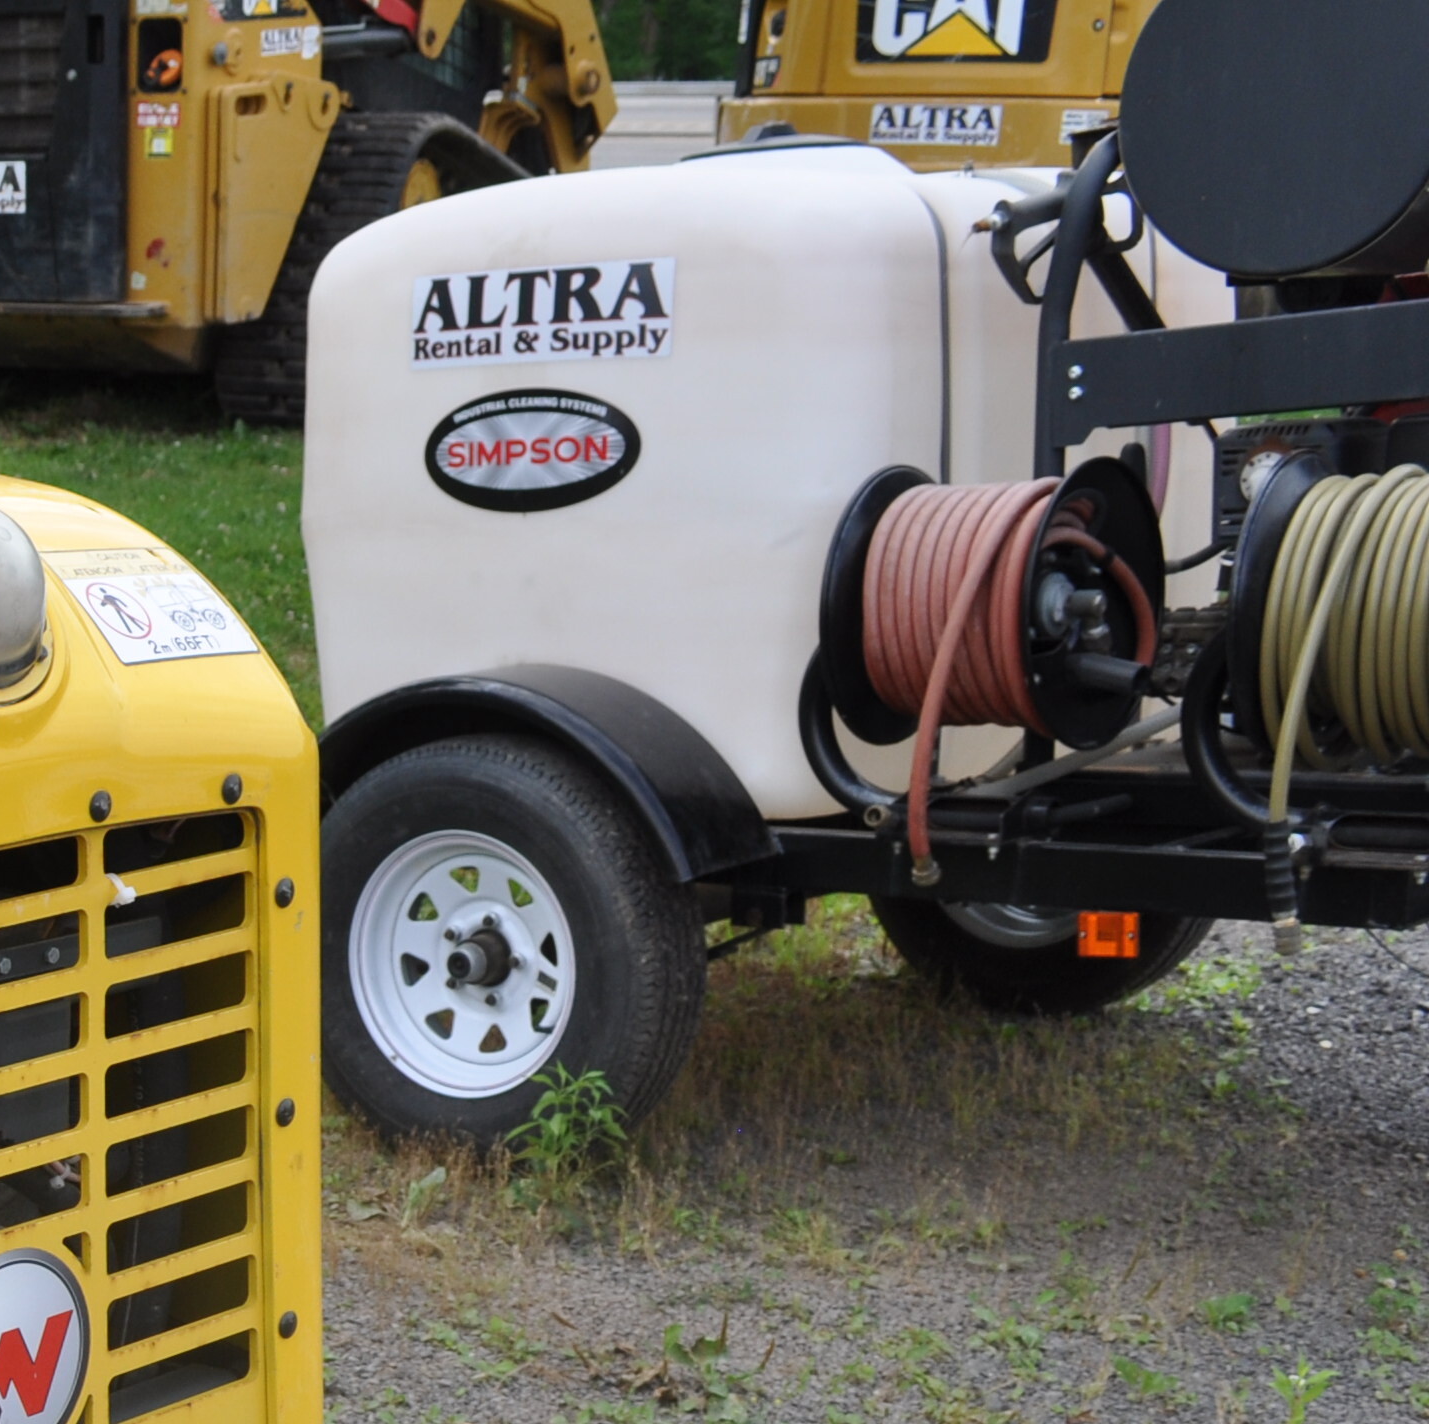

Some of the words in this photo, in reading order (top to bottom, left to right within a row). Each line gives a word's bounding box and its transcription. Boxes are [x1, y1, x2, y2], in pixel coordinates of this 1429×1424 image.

[874, 106, 994, 129] ALTRA
[413, 262, 669, 334] ALTRA
[413, 332, 502, 361] Rental
[513, 330, 540, 354] &
[550, 323, 669, 356] Supply
[452, 399, 507, 424] INDUSTRIAL
[508, 396, 558, 409] CLEANING
[559, 397, 608, 418] SYSTEMS
[447, 435, 609, 468] SIMPSON
